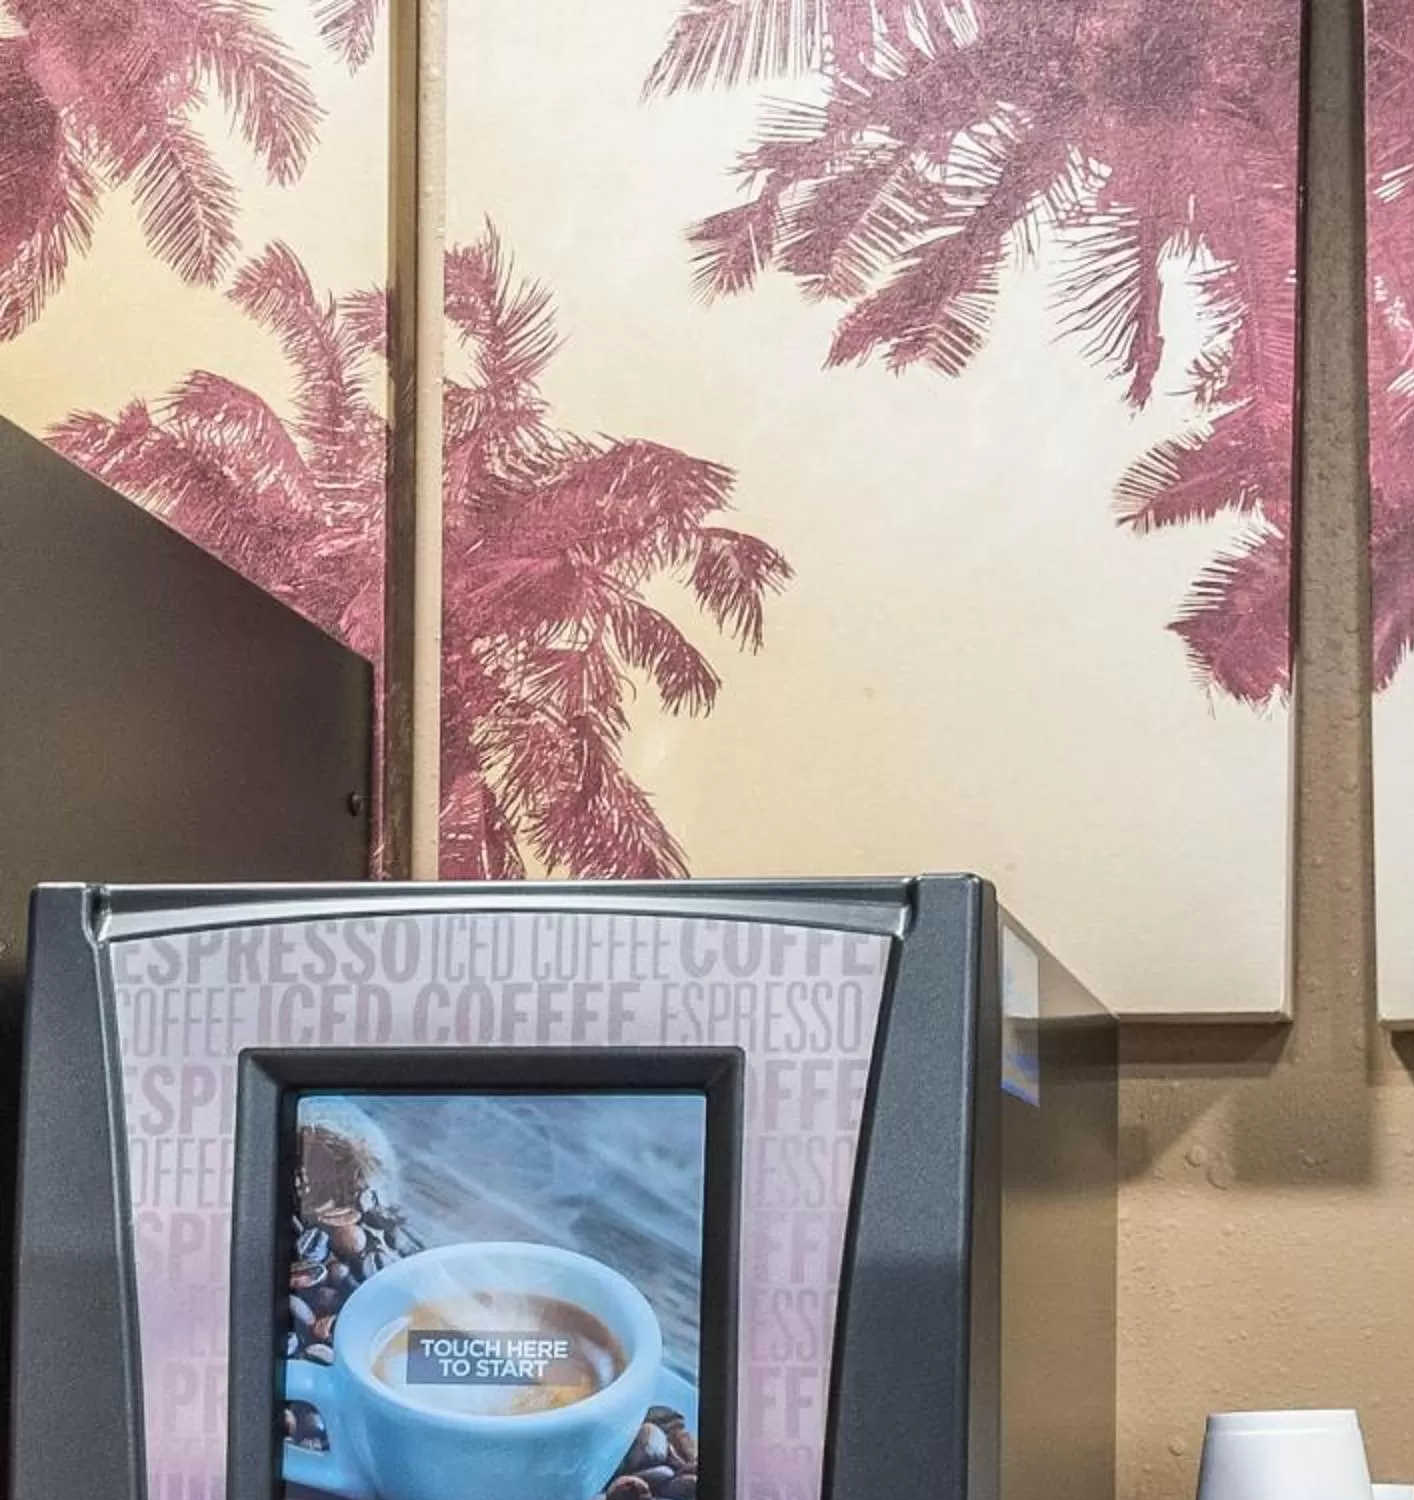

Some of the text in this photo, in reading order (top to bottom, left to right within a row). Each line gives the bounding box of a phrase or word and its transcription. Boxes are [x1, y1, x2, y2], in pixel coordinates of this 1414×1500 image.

[115, 915, 889, 985] ESPRESSO ICED COFFEE COFFE
[661, 980, 863, 1054] ESPRESSO
[420, 1339, 569, 1358] TOUCH HERE
[438, 1359, 549, 1378] TO START
